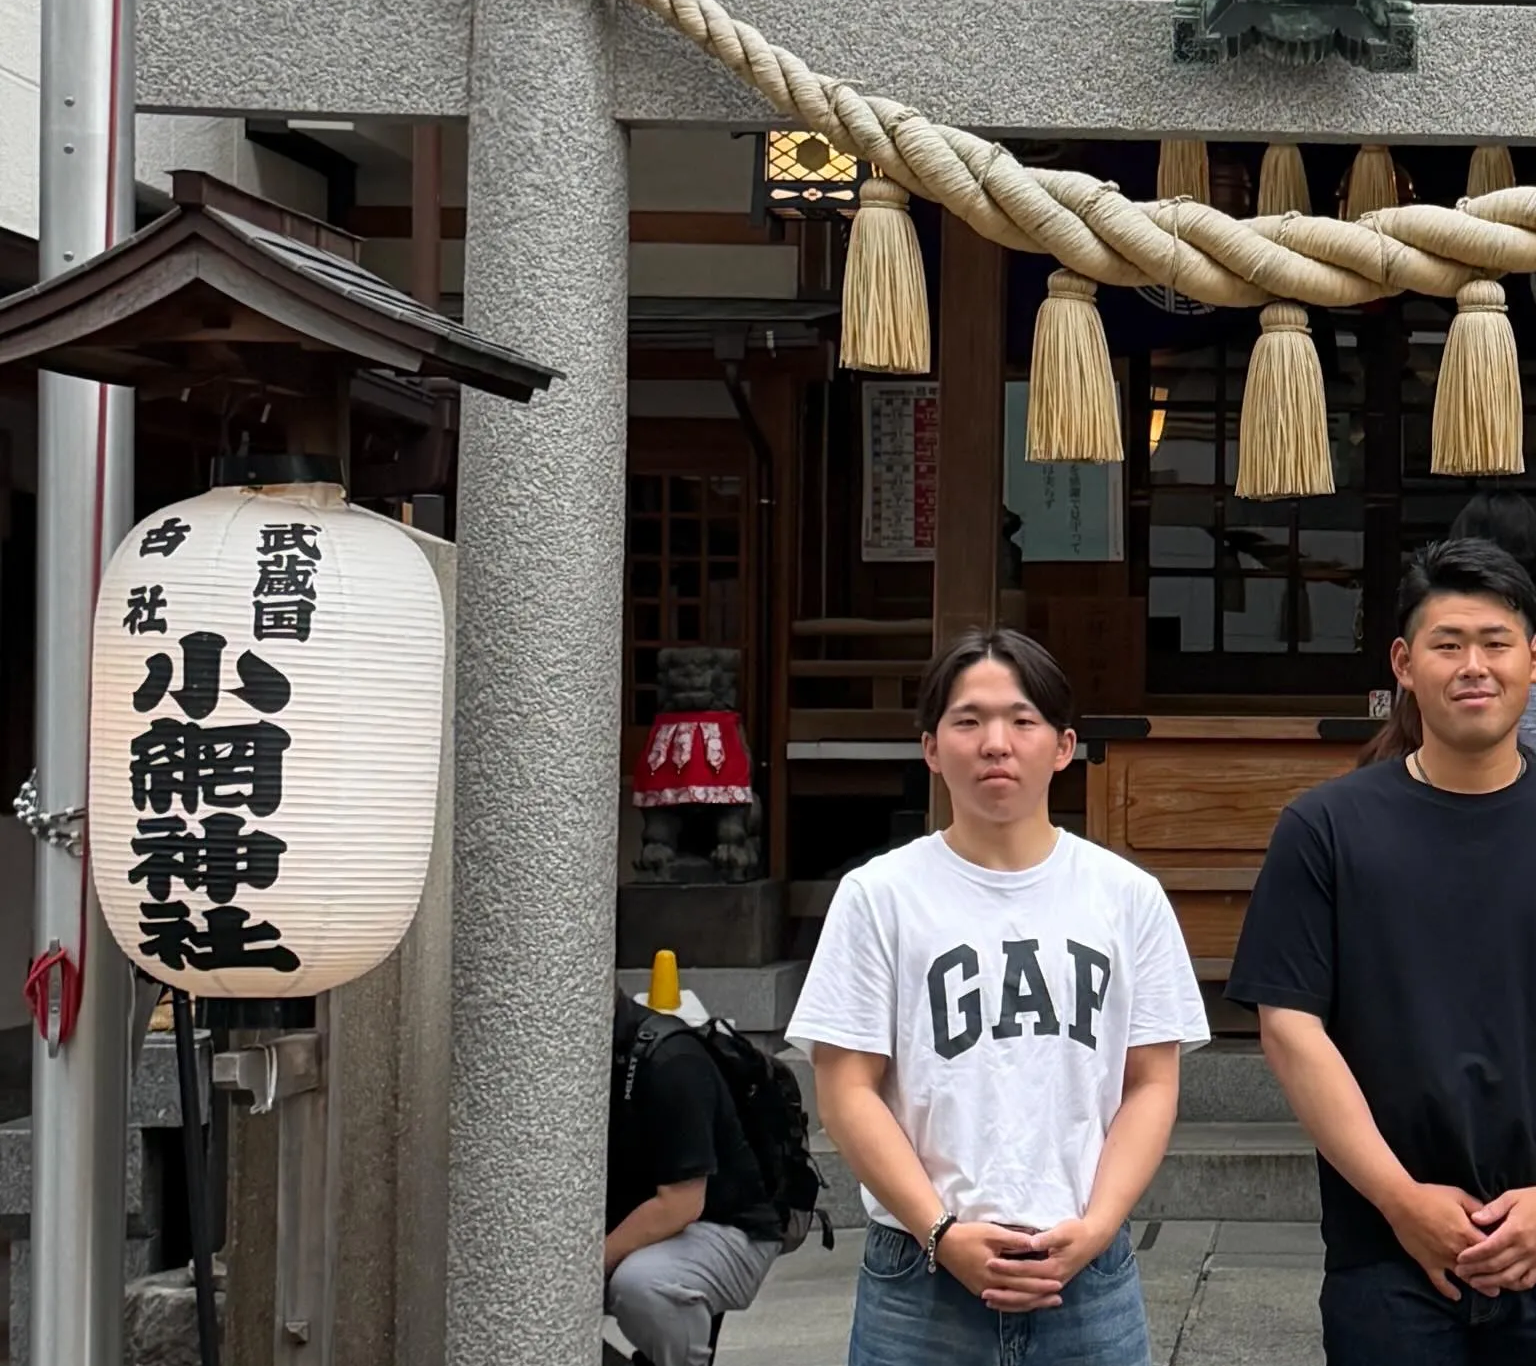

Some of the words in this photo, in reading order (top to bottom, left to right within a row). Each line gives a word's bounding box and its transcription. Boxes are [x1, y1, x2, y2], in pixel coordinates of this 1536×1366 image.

[122, 516, 192, 636] 古社
[252, 522, 323, 643] 武蔵国
[127, 630, 303, 973] 小網神社
[927, 938, 1111, 1060] GAP
